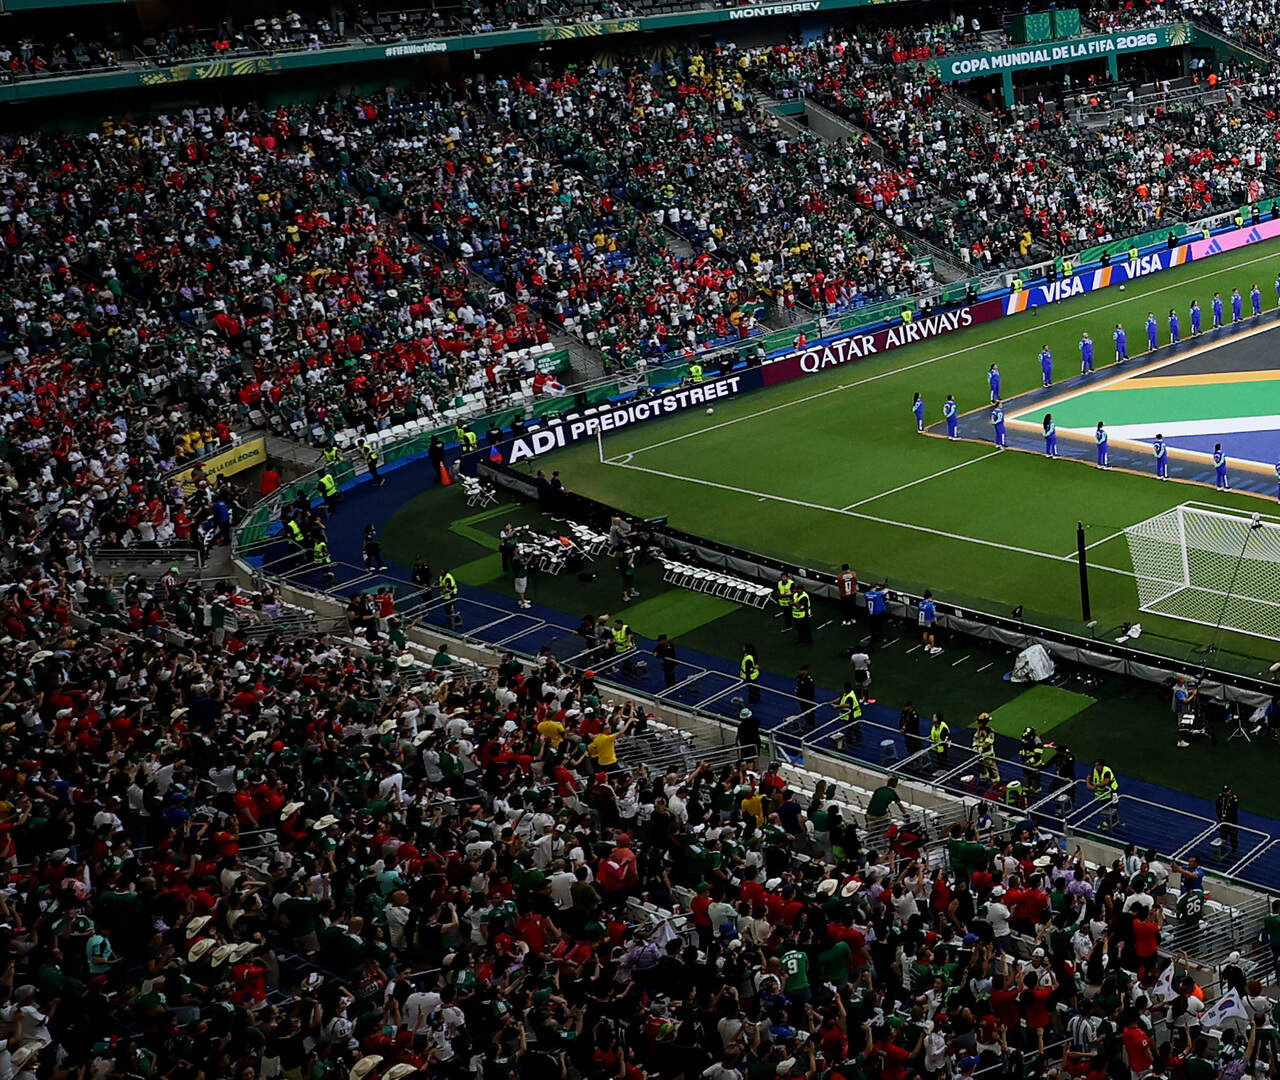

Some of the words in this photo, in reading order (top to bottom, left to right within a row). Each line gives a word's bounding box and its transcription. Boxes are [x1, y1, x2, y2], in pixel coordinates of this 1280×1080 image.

[729, 1, 821, 20] MONTERREY
[385, 41, 448, 57] #FIFAWorldCup
[951, 59, 990, 75] COPA
[991, 51, 1052, 70] MUNDIAL
[1052, 48, 1070, 61] DE
[1070, 43, 1088, 57] LA
[1089, 39, 1115, 54] FIFA
[1116, 32, 1158, 49] 2026
[1121, 253, 1163, 280] VISA
[1039, 275, 1084, 303] VISA
[800, 334, 878, 374] QATAR
[885, 306, 973, 350] AIRWAYS
[509, 425, 566, 464] ADI
[571, 376, 741, 440] PREDICTSTREET
[224, 459, 237, 470] FIFA
[237, 449, 260, 463] 2026
[1187, 899, 1201, 915] 26
[787, 958, 798, 975] 9
